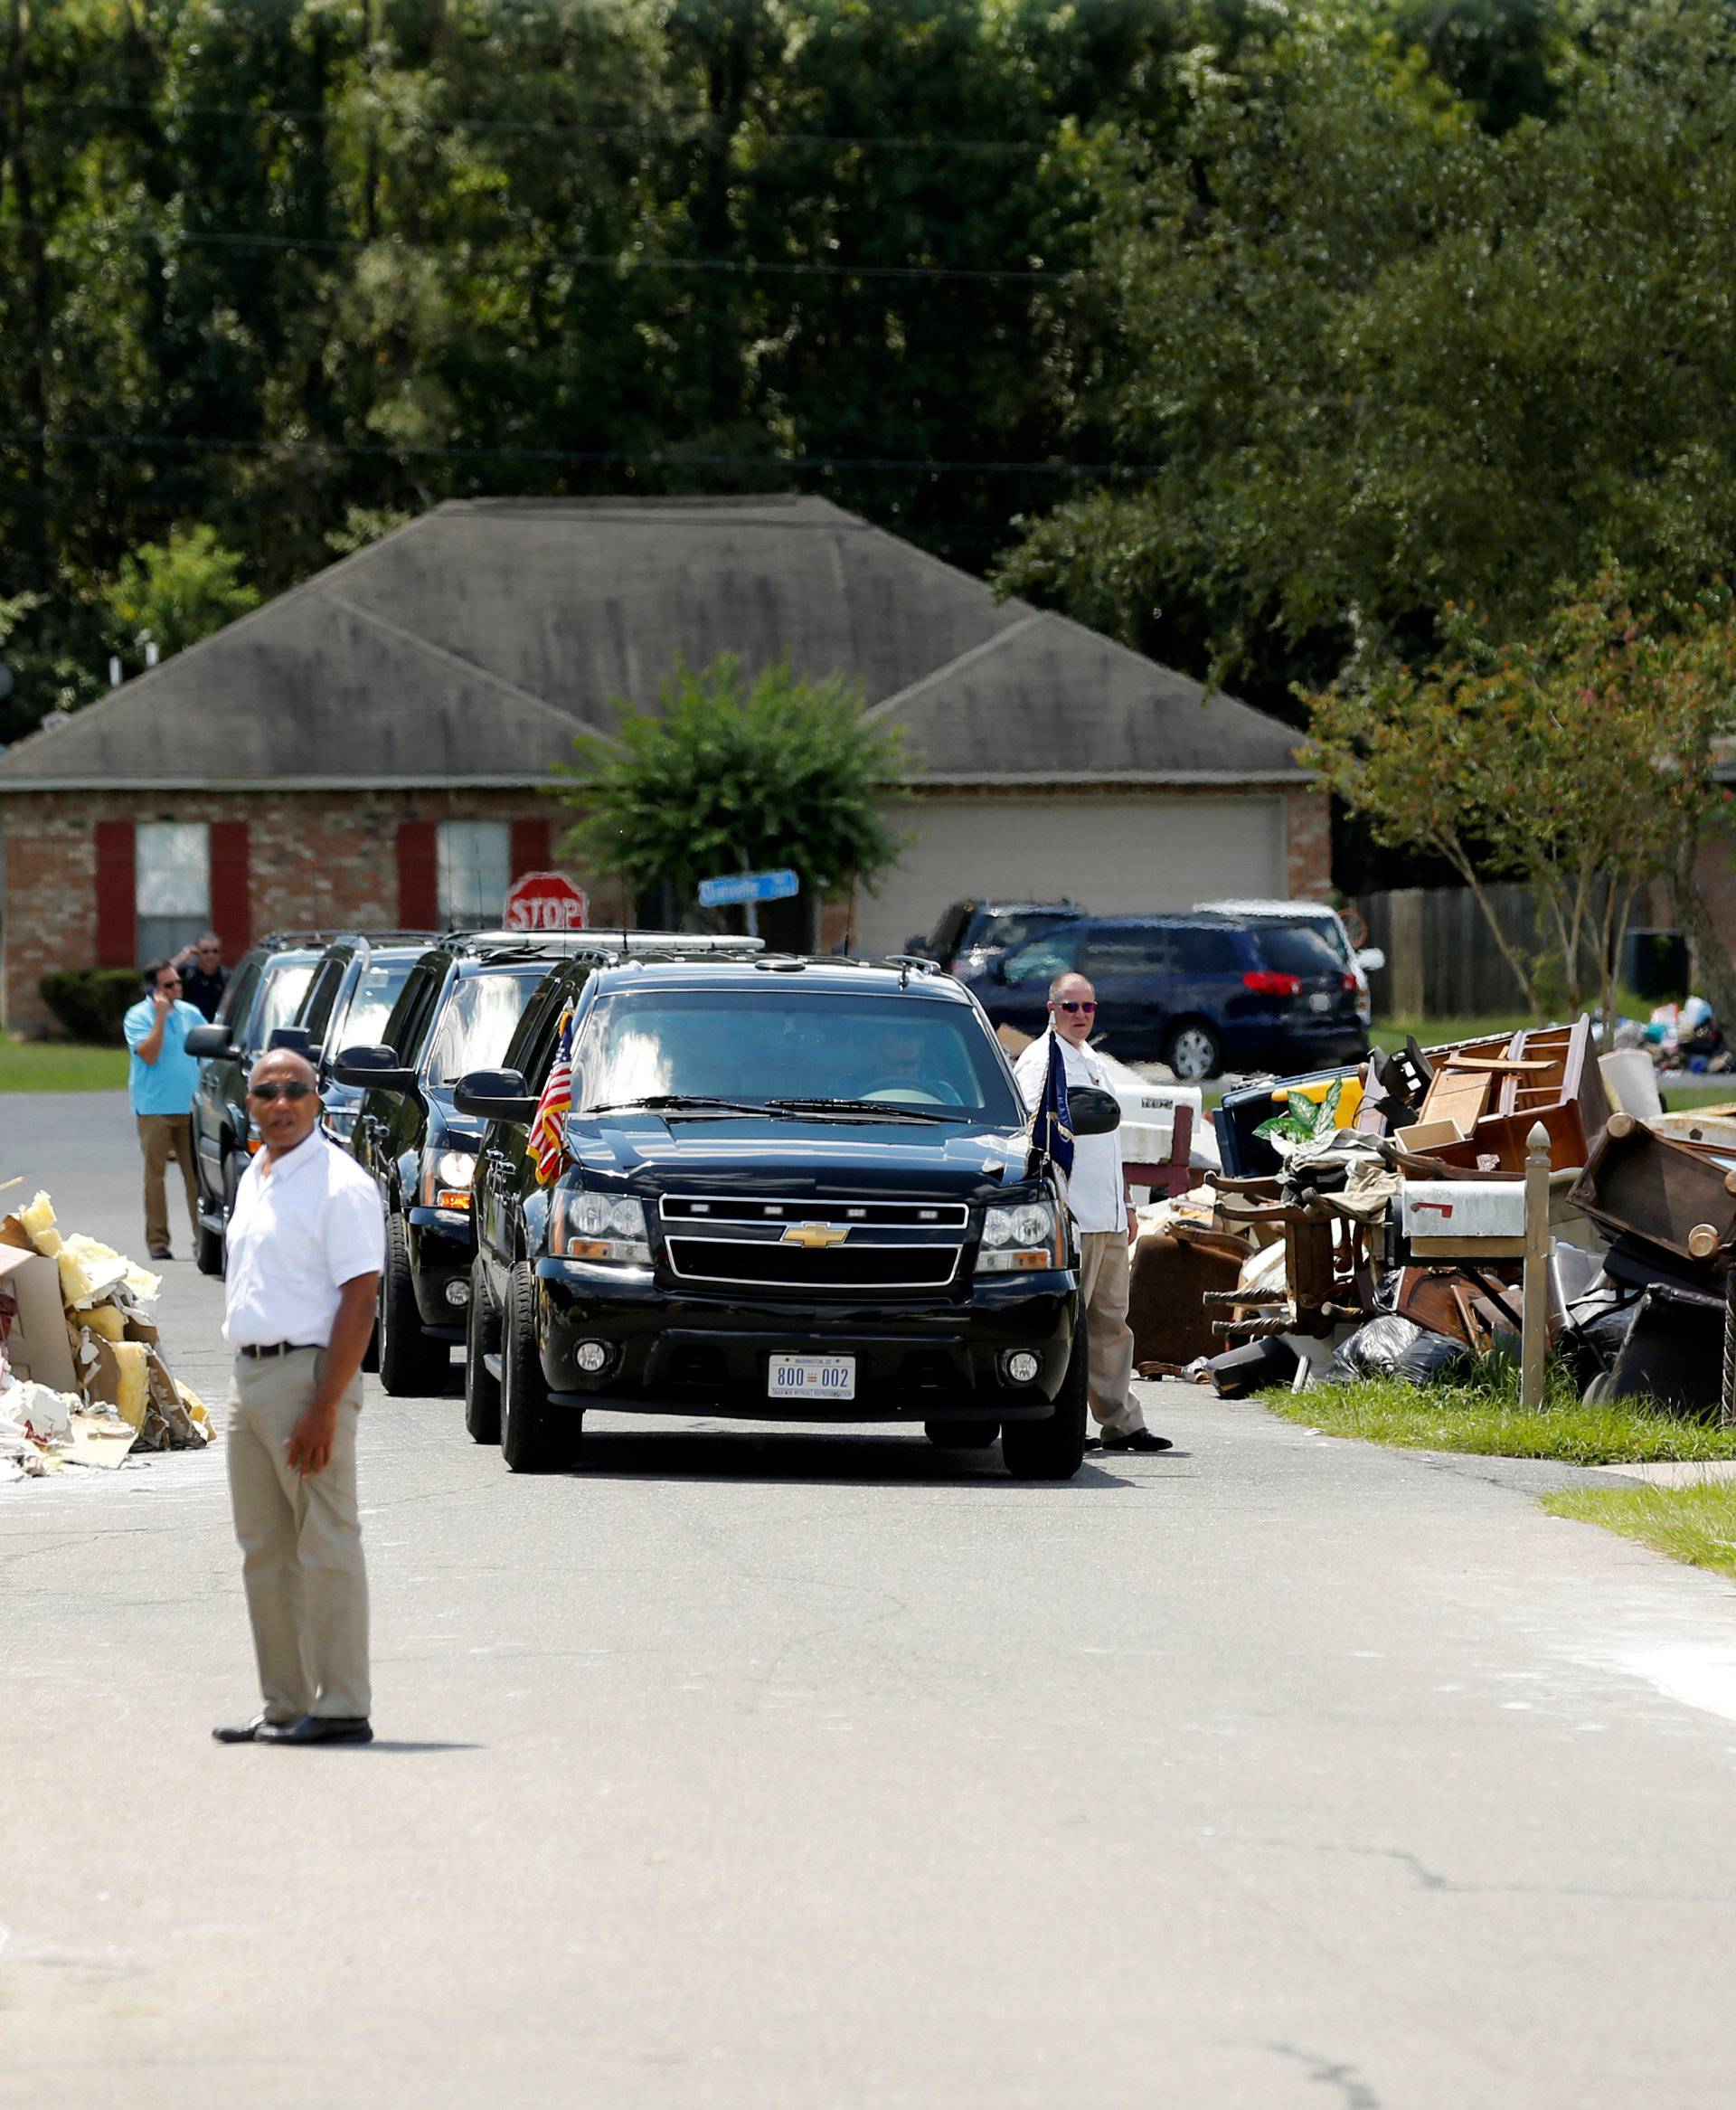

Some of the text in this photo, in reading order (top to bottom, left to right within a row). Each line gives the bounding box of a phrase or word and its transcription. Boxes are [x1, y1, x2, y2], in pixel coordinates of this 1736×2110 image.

[510, 896, 579, 930] STOP
[778, 1367, 848, 1388] 800 002
